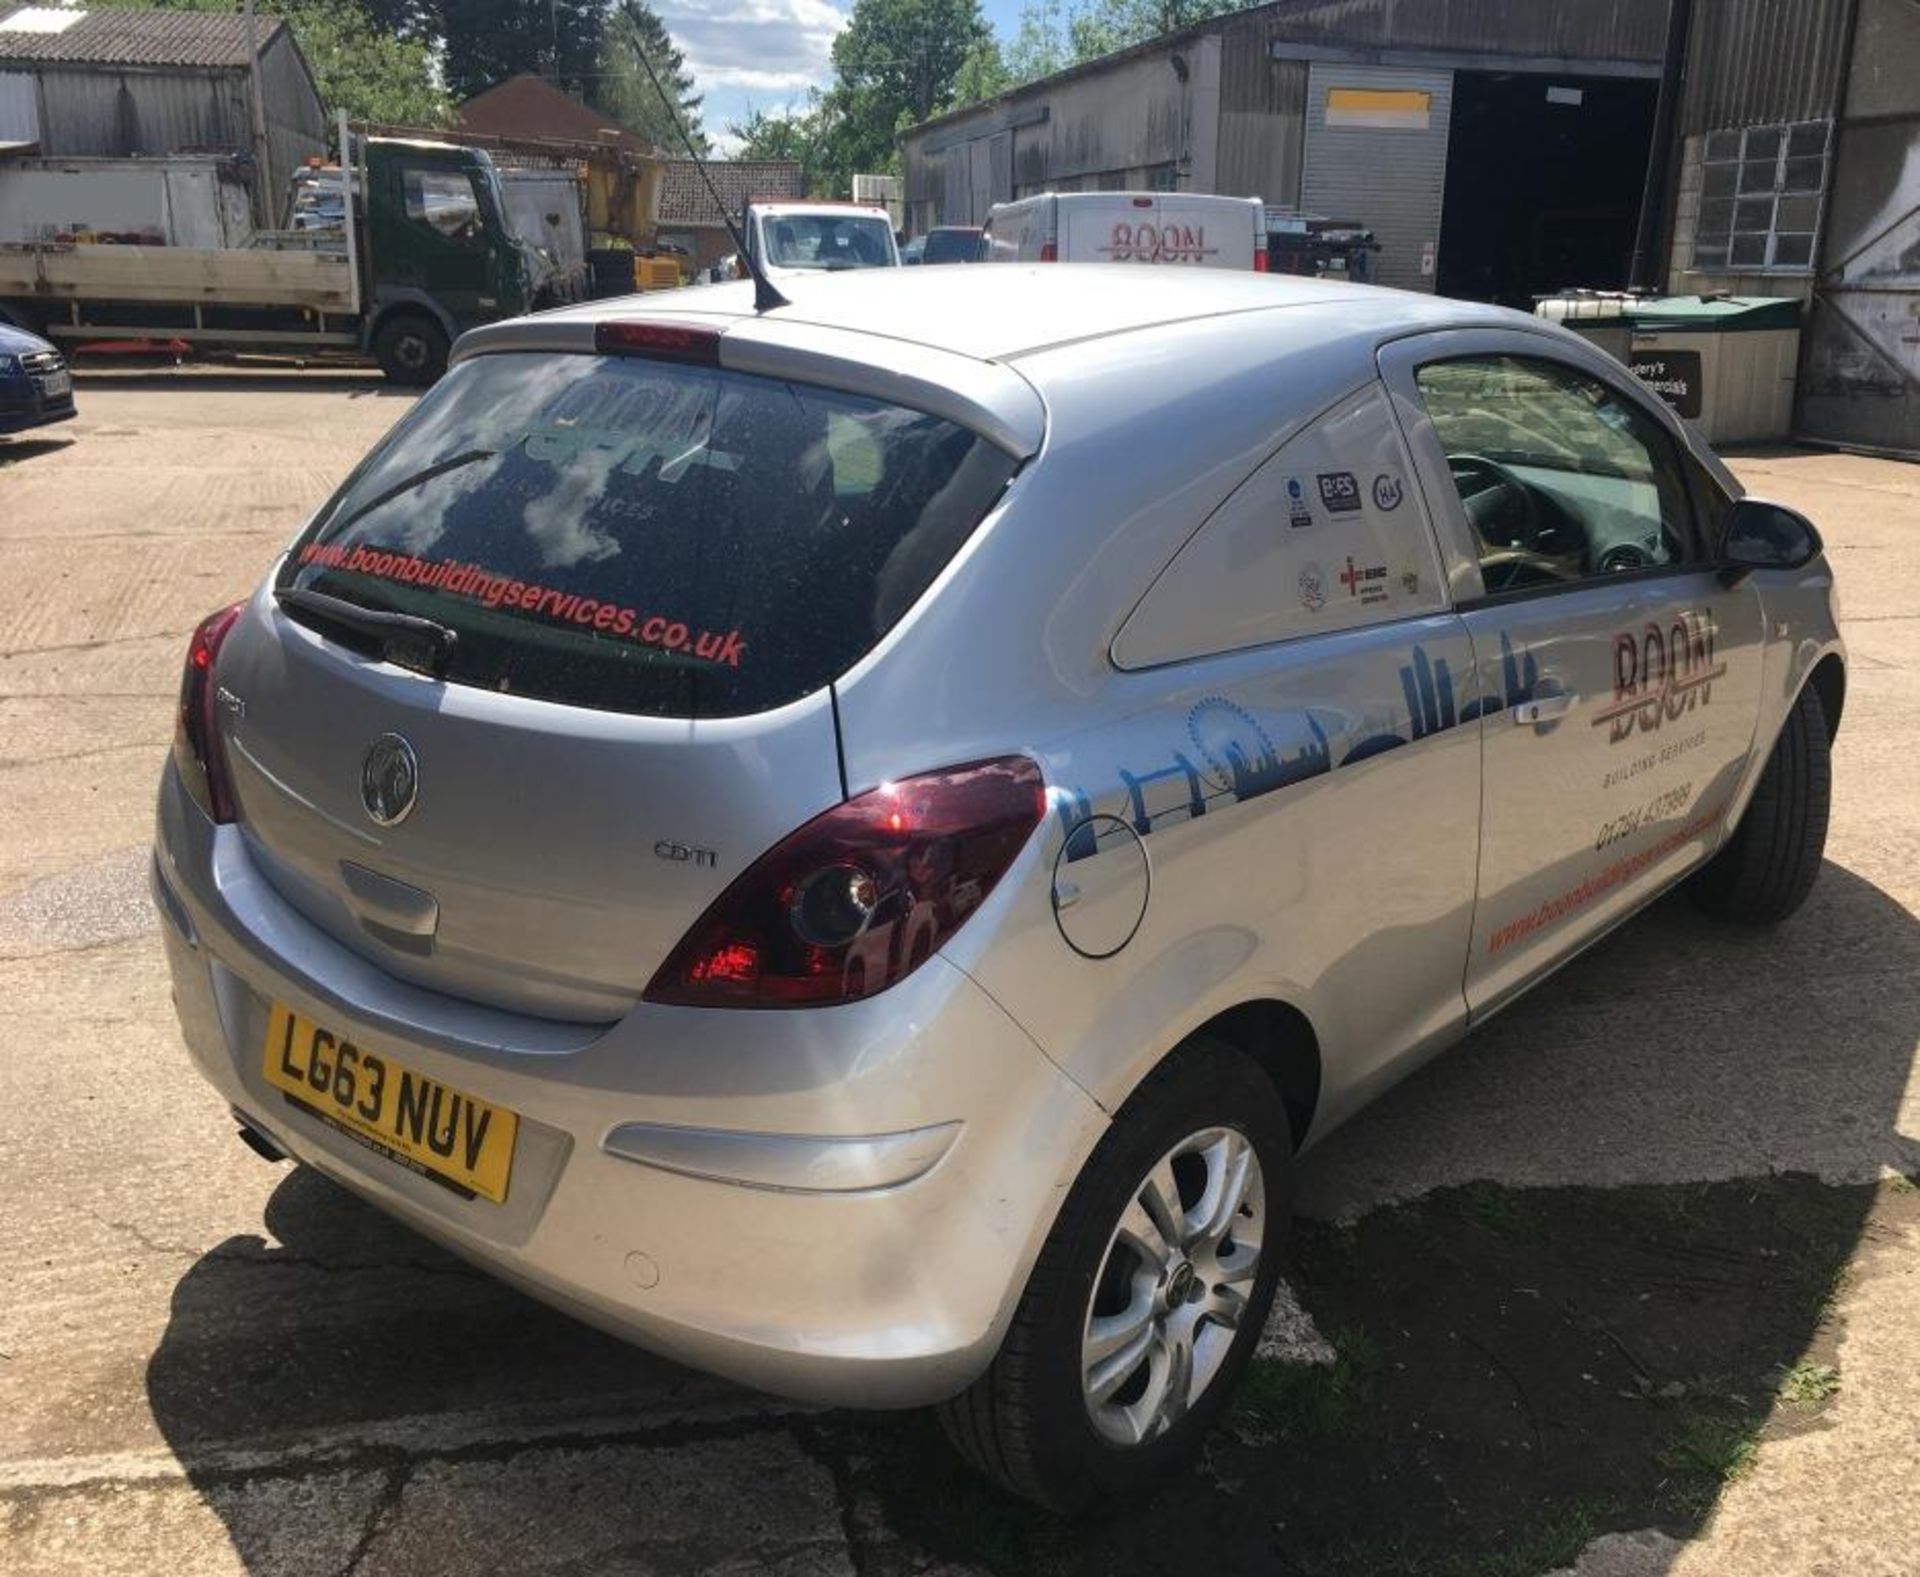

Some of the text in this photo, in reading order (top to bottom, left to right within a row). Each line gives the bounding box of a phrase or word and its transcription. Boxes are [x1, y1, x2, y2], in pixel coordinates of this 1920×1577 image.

[1111, 223, 1205, 262] BOON
[300, 540, 746, 667] www.boonbuildingservices.co.uk
[1608, 608, 1716, 744] BOON
[281, 1012, 386, 1122] LG63
[395, 1071, 491, 1171] NUV
